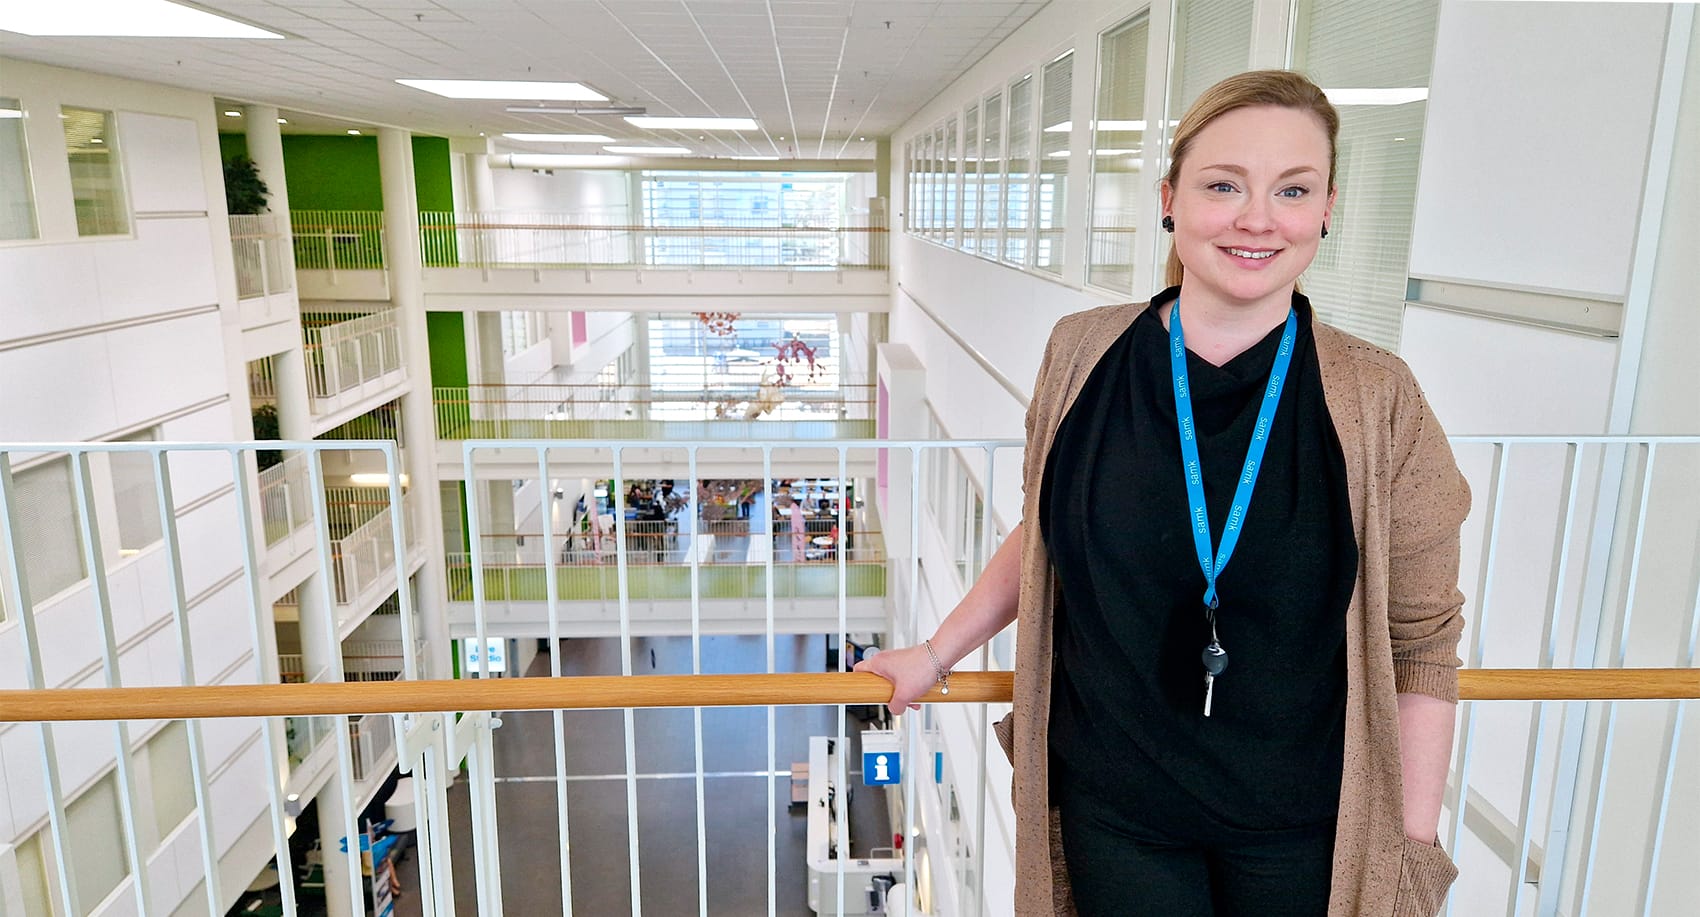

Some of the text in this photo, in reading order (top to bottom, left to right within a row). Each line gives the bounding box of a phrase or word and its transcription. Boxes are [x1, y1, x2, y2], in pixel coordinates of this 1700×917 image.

[1174, 335, 1183, 358] samk
[1279, 335, 1291, 357] samk
[1176, 374, 1187, 398] samk
[1267, 375, 1280, 398] samk
[1181, 416, 1193, 441] samk
[1255, 416, 1268, 441] samk
[1187, 459, 1200, 485] samk
[1242, 459, 1256, 485] samk
[1194, 506, 1207, 534] samk
[1228, 504, 1242, 532] samk
